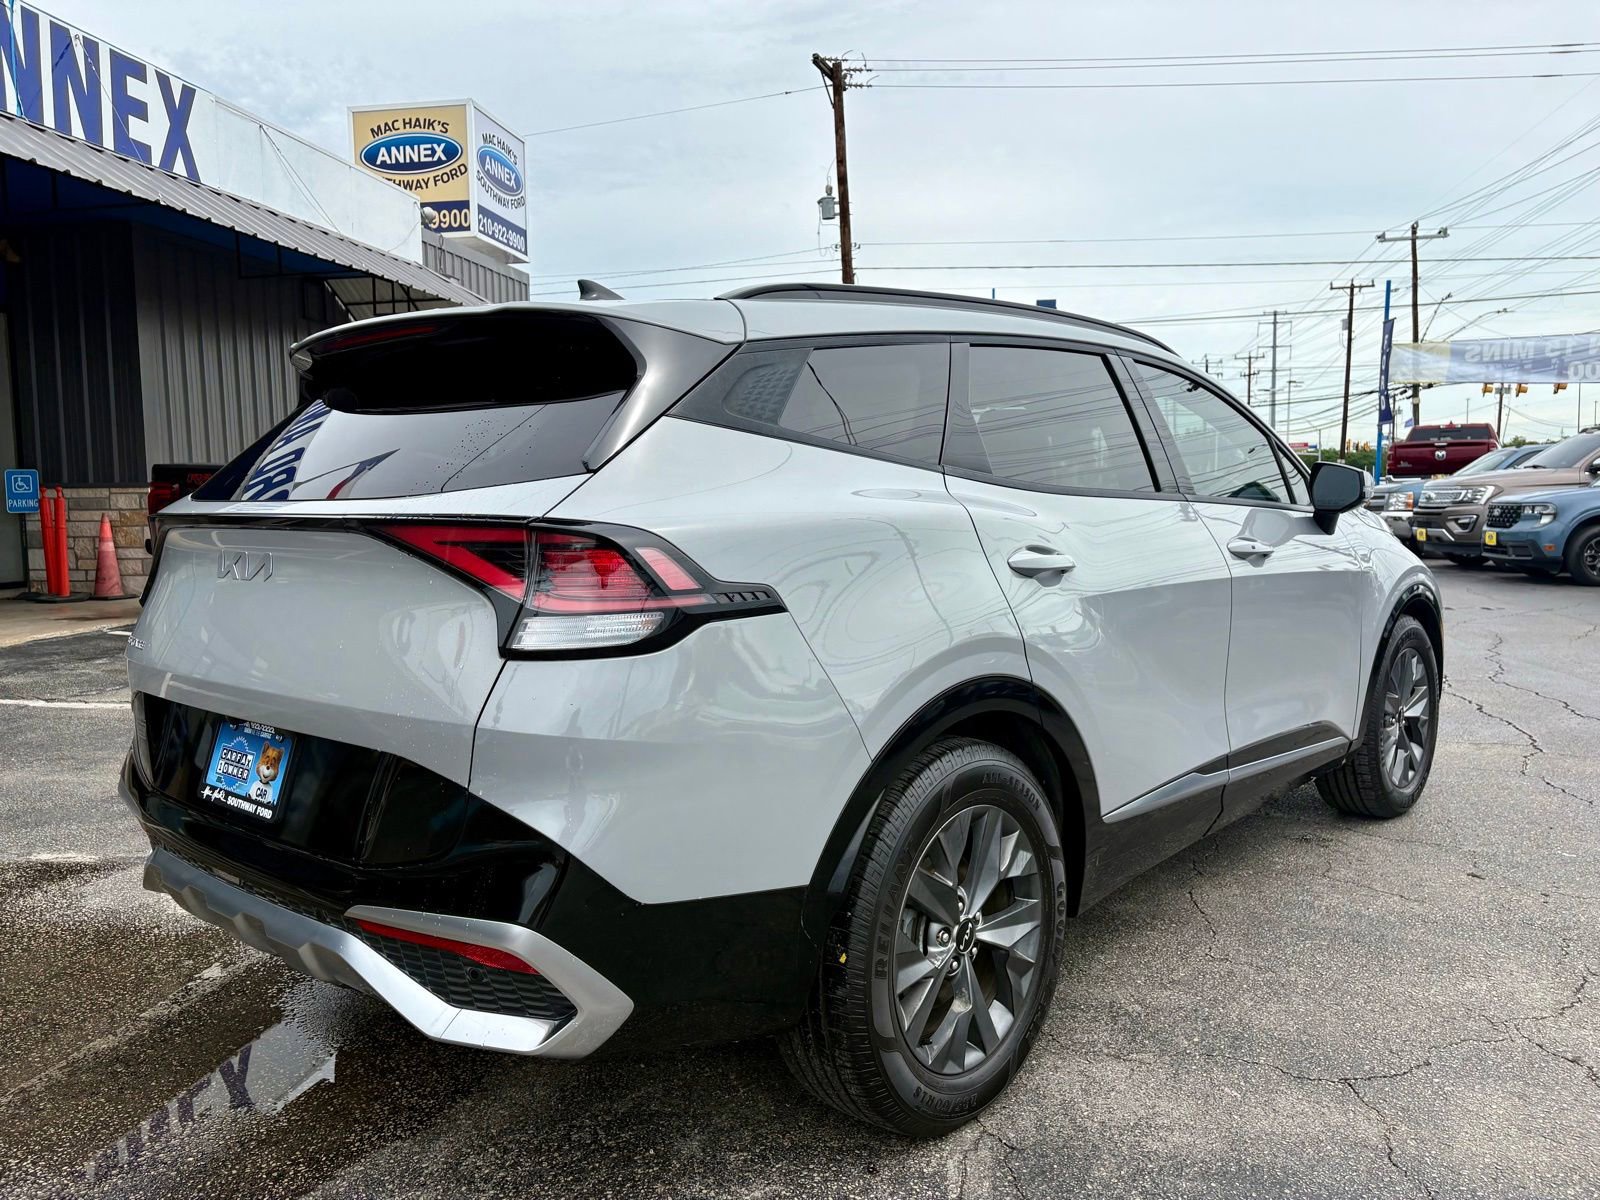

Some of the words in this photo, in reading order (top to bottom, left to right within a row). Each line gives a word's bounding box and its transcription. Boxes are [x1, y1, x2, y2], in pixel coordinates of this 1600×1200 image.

[0, 3, 201, 183] NNEX
[370, 119, 400, 138] MAC
[402, 117, 450, 134] HAIK'S
[376, 143, 448, 165] ANNEX
[482, 132, 496, 145] MAC
[496, 139, 518, 166] HAIK'S
[433, 163, 468, 187] FORD
[485, 156, 517, 190] ANNEX
[476, 169, 509, 210] SOUTHWAY
[510, 195, 526, 210] FORD
[479, 213, 525, 252] 210-922-9900
[8, 499, 39, 508] PARKING
[222, 748, 253, 769] CARFAX
[255, 786, 268, 801] CAR
[226, 795, 256, 815] SOUTHWAY
[256, 806, 273, 820] FORD
